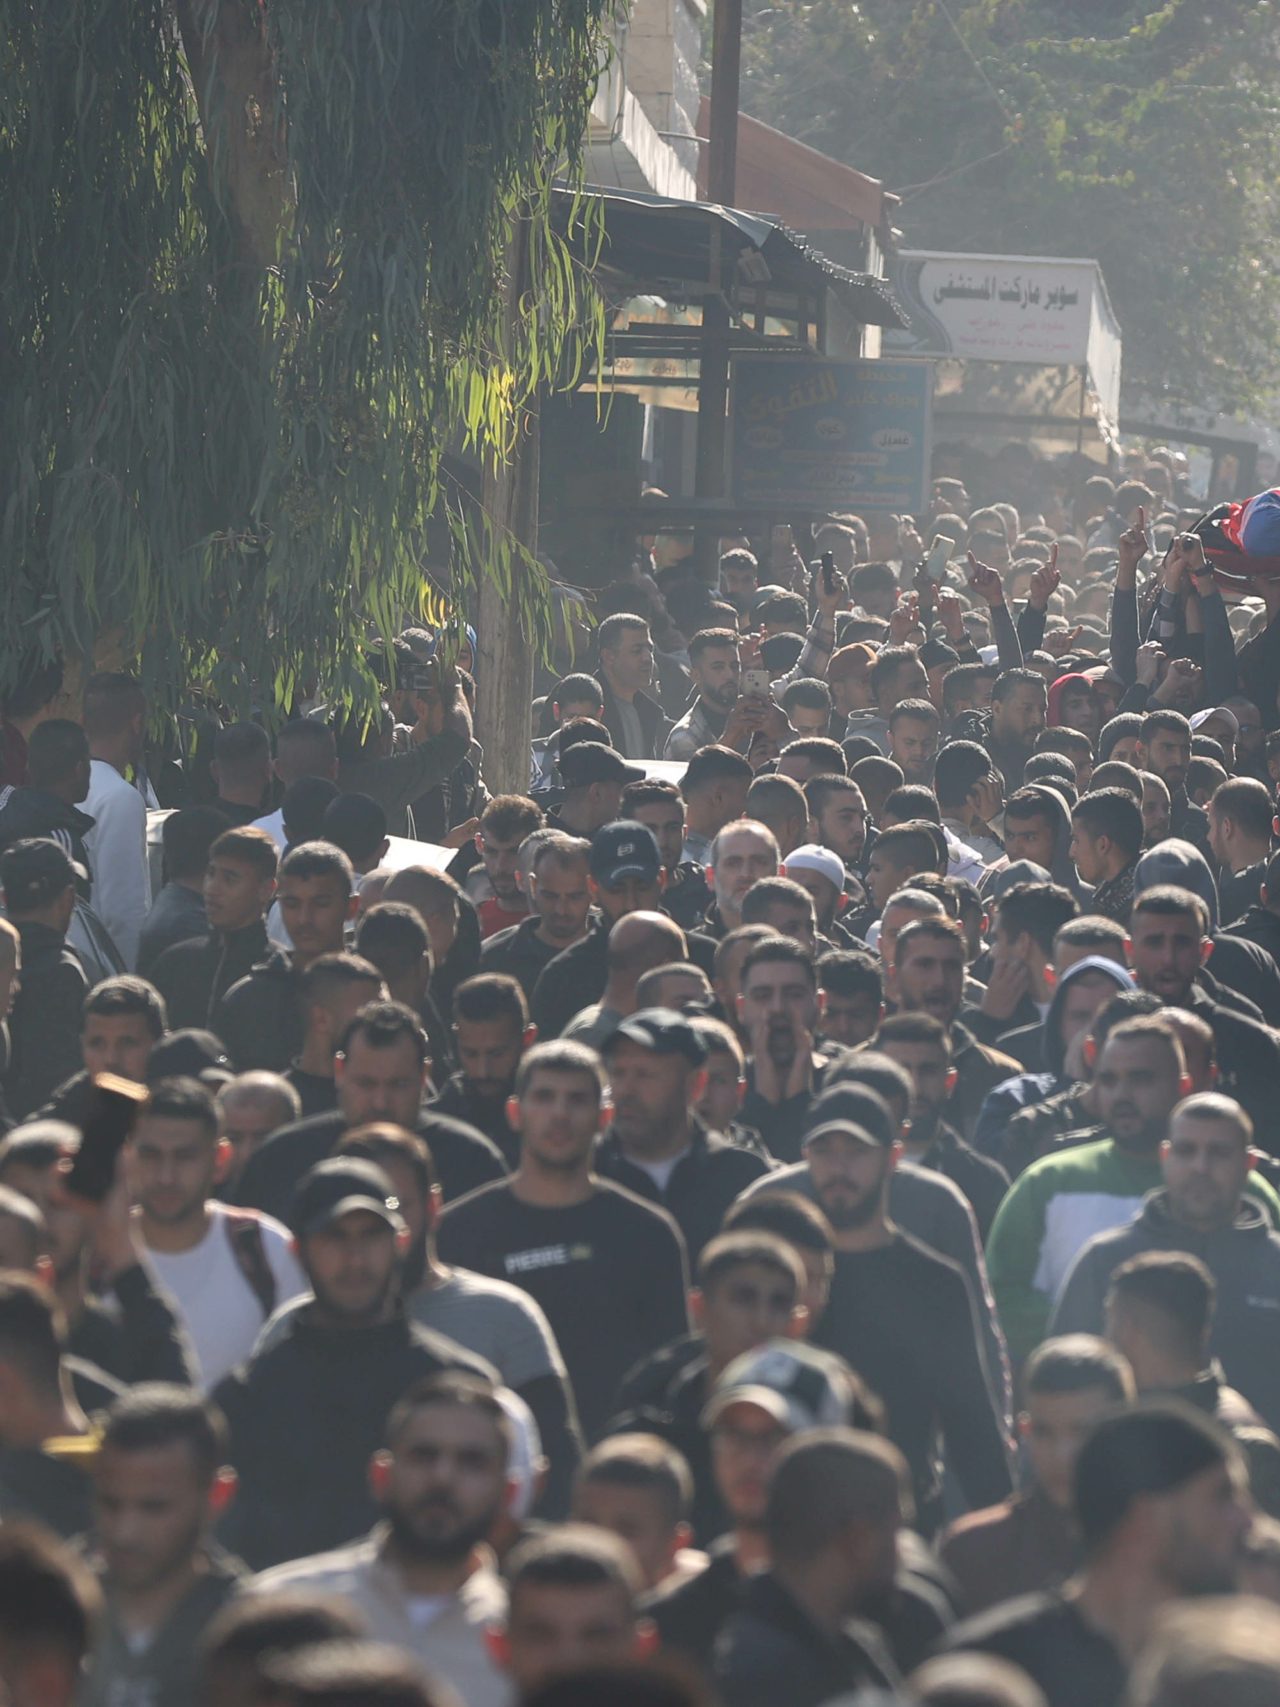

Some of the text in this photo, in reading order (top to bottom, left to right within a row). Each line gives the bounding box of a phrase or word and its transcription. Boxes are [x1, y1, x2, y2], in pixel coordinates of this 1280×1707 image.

[998, 275, 1041, 310] ماركت
[1043, 284, 1079, 311] سوبر
[878, 432, 911, 447] غسيل
